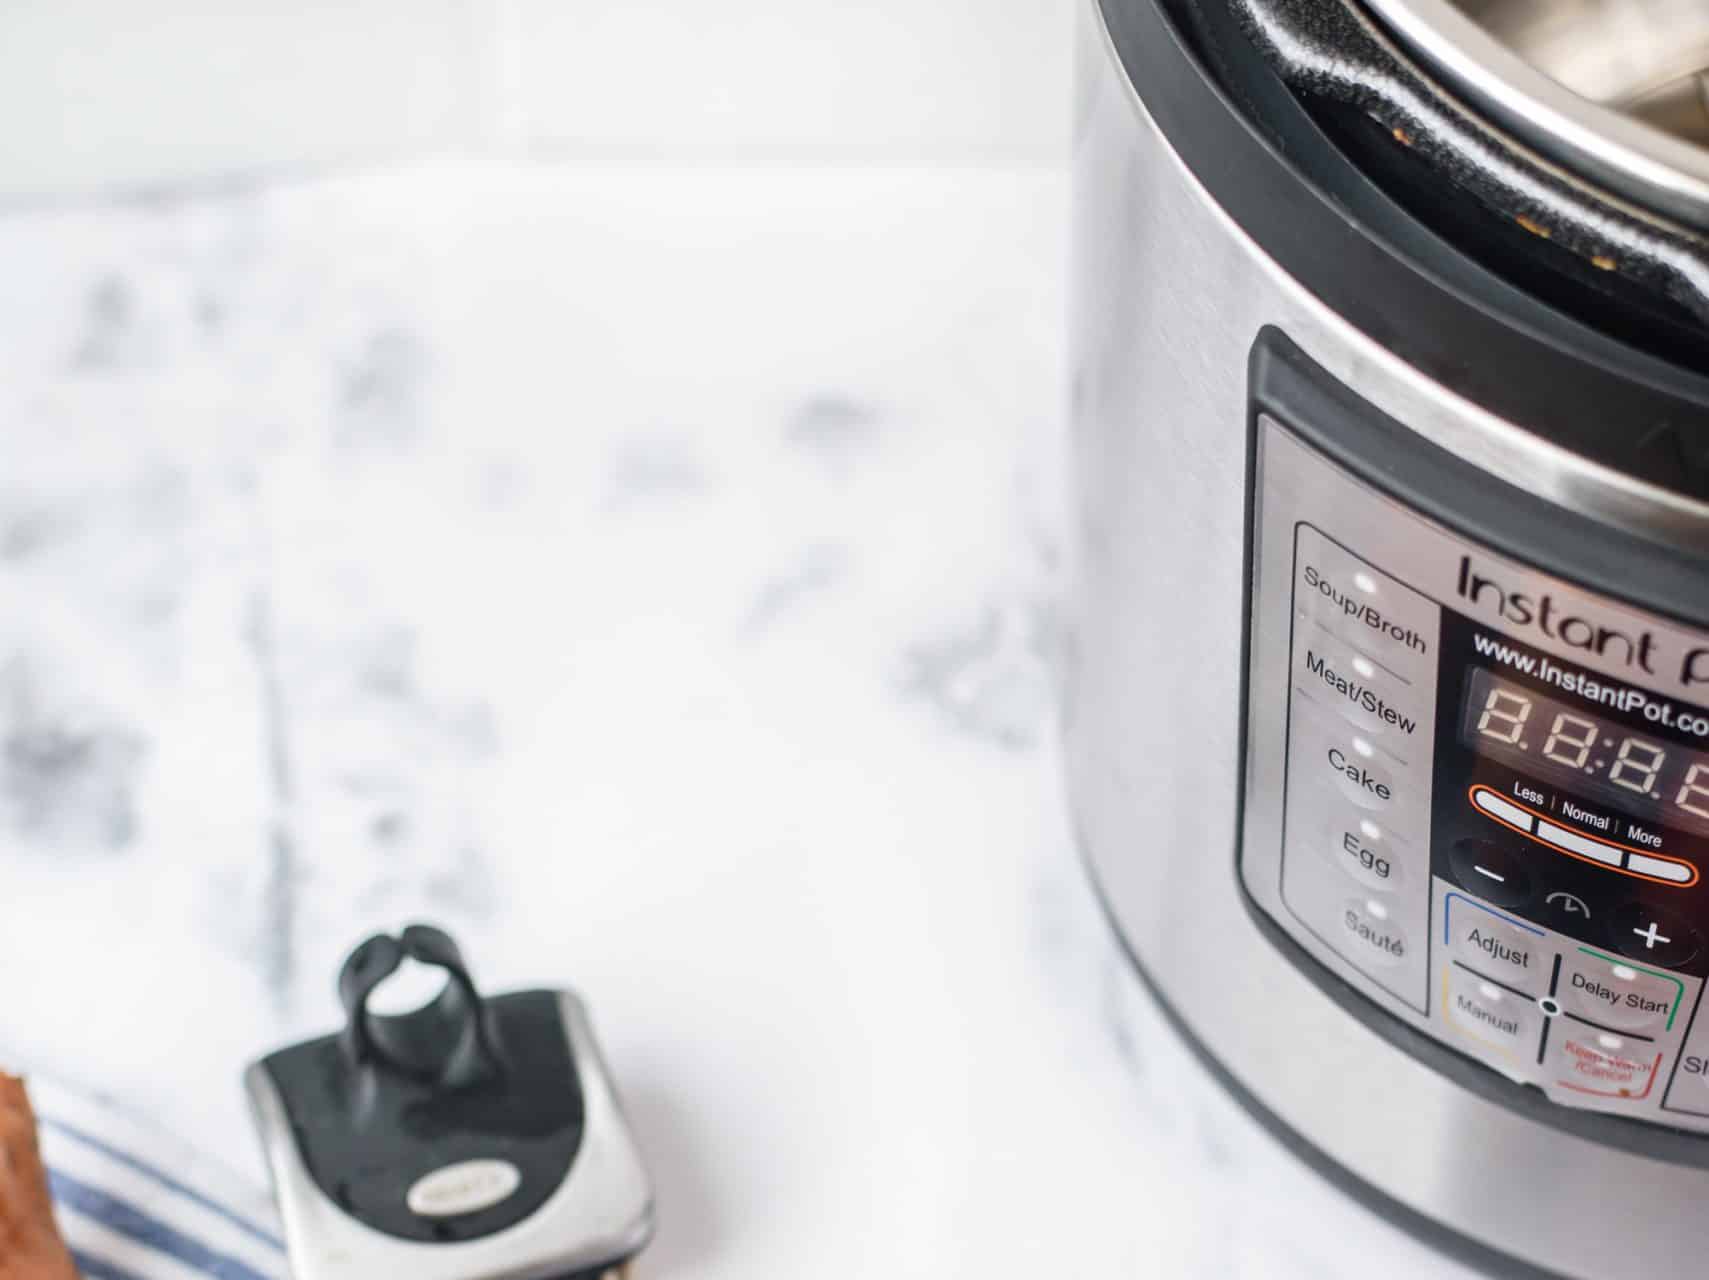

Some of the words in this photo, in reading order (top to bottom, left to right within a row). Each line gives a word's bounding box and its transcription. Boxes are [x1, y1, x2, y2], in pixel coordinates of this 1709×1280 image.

[1303, 565, 1427, 655] Soup/Broth
[1457, 555, 1655, 675] Instant
[1306, 650, 1416, 735] Meat/Stew
[1328, 748, 1391, 800] Cake
[1513, 780, 1544, 806] Less
[1562, 800, 1609, 831] Normal
[1627, 824, 1662, 848] More
[1343, 831, 1390, 878] Egg
[1468, 928, 1529, 969] Adjust
[1457, 994, 1518, 1036] Manual
[1571, 972, 1621, 1006] Delay
[1625, 993, 1669, 1015] Start
